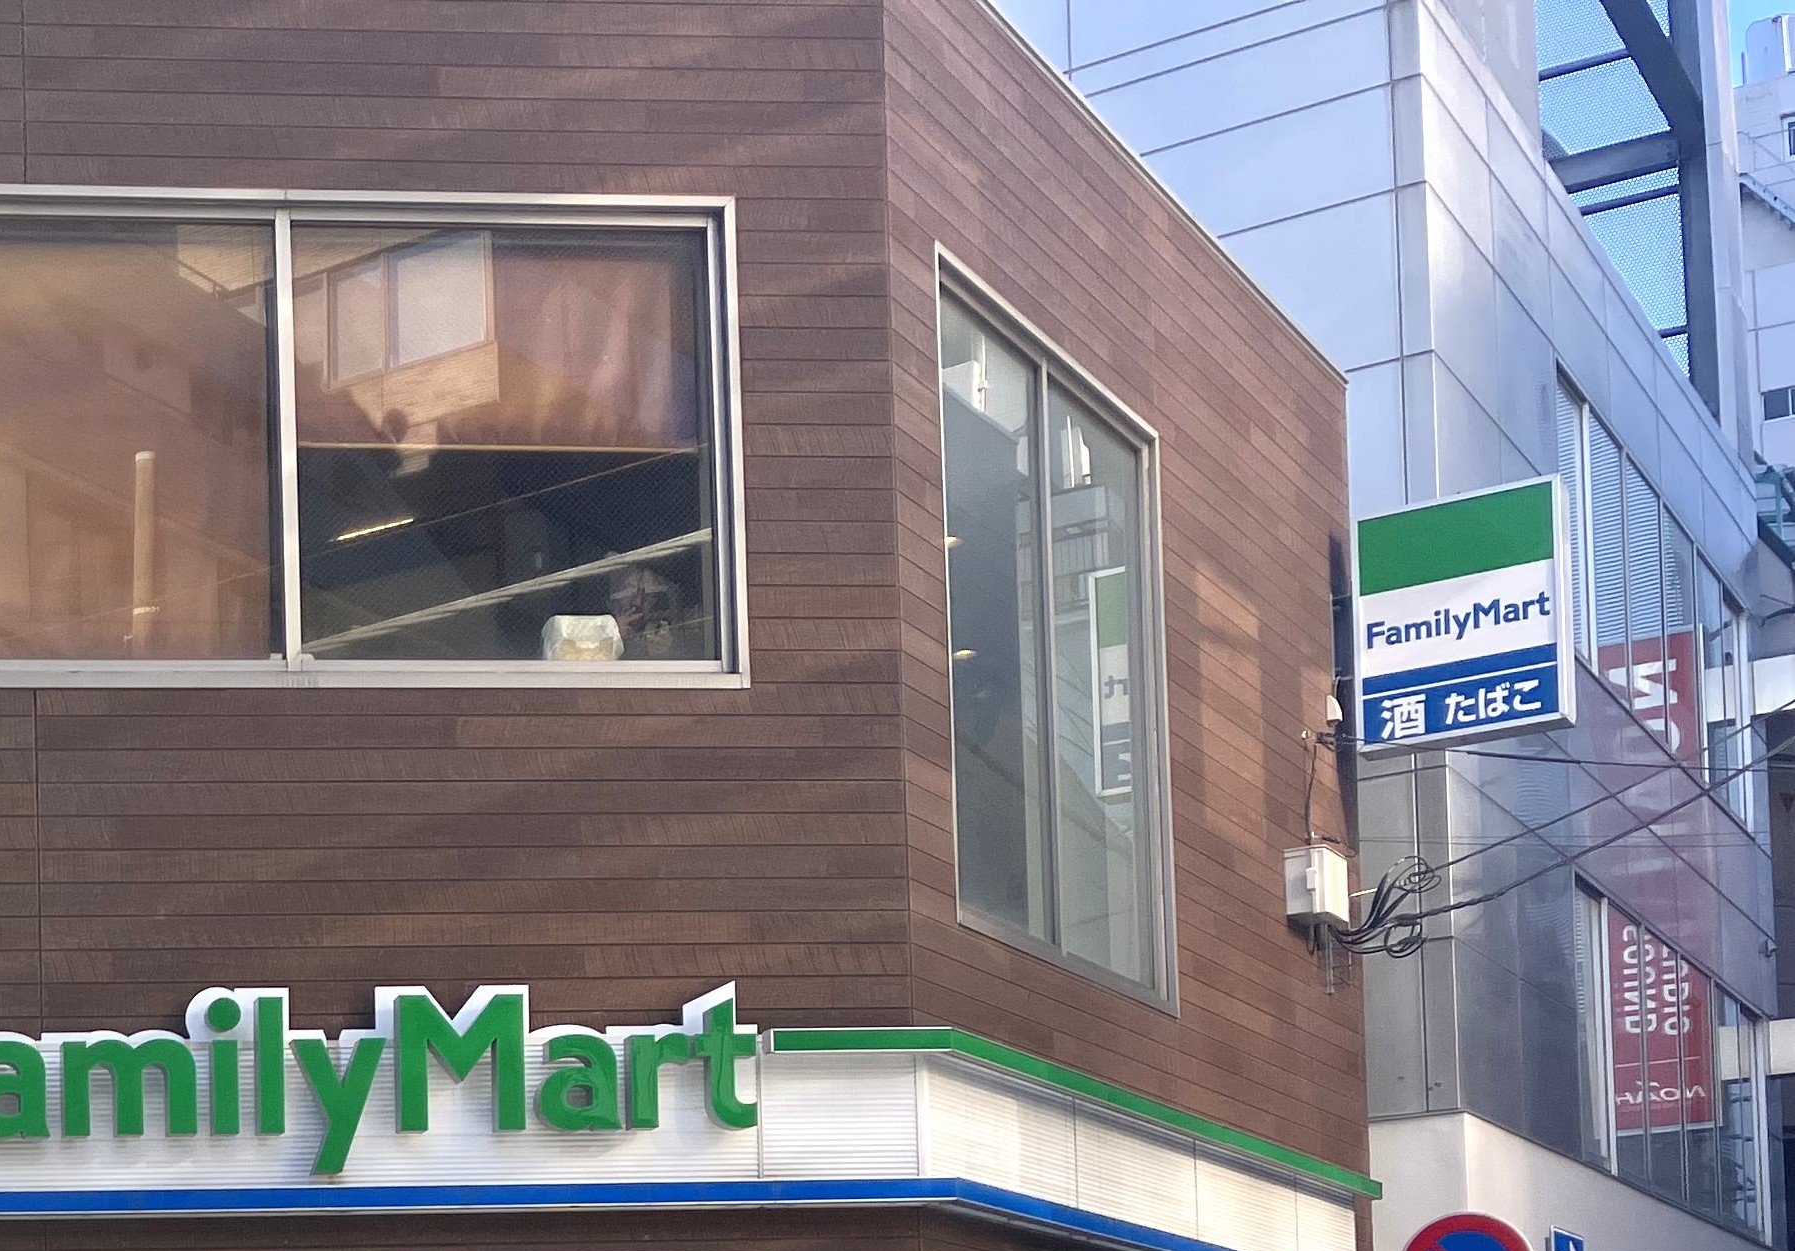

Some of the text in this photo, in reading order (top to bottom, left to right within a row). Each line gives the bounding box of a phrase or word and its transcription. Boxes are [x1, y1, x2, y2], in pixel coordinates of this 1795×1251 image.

[1365, 590, 1550, 650] FamilyMart
[1380, 679, 1541, 737] 酒 たばこ
